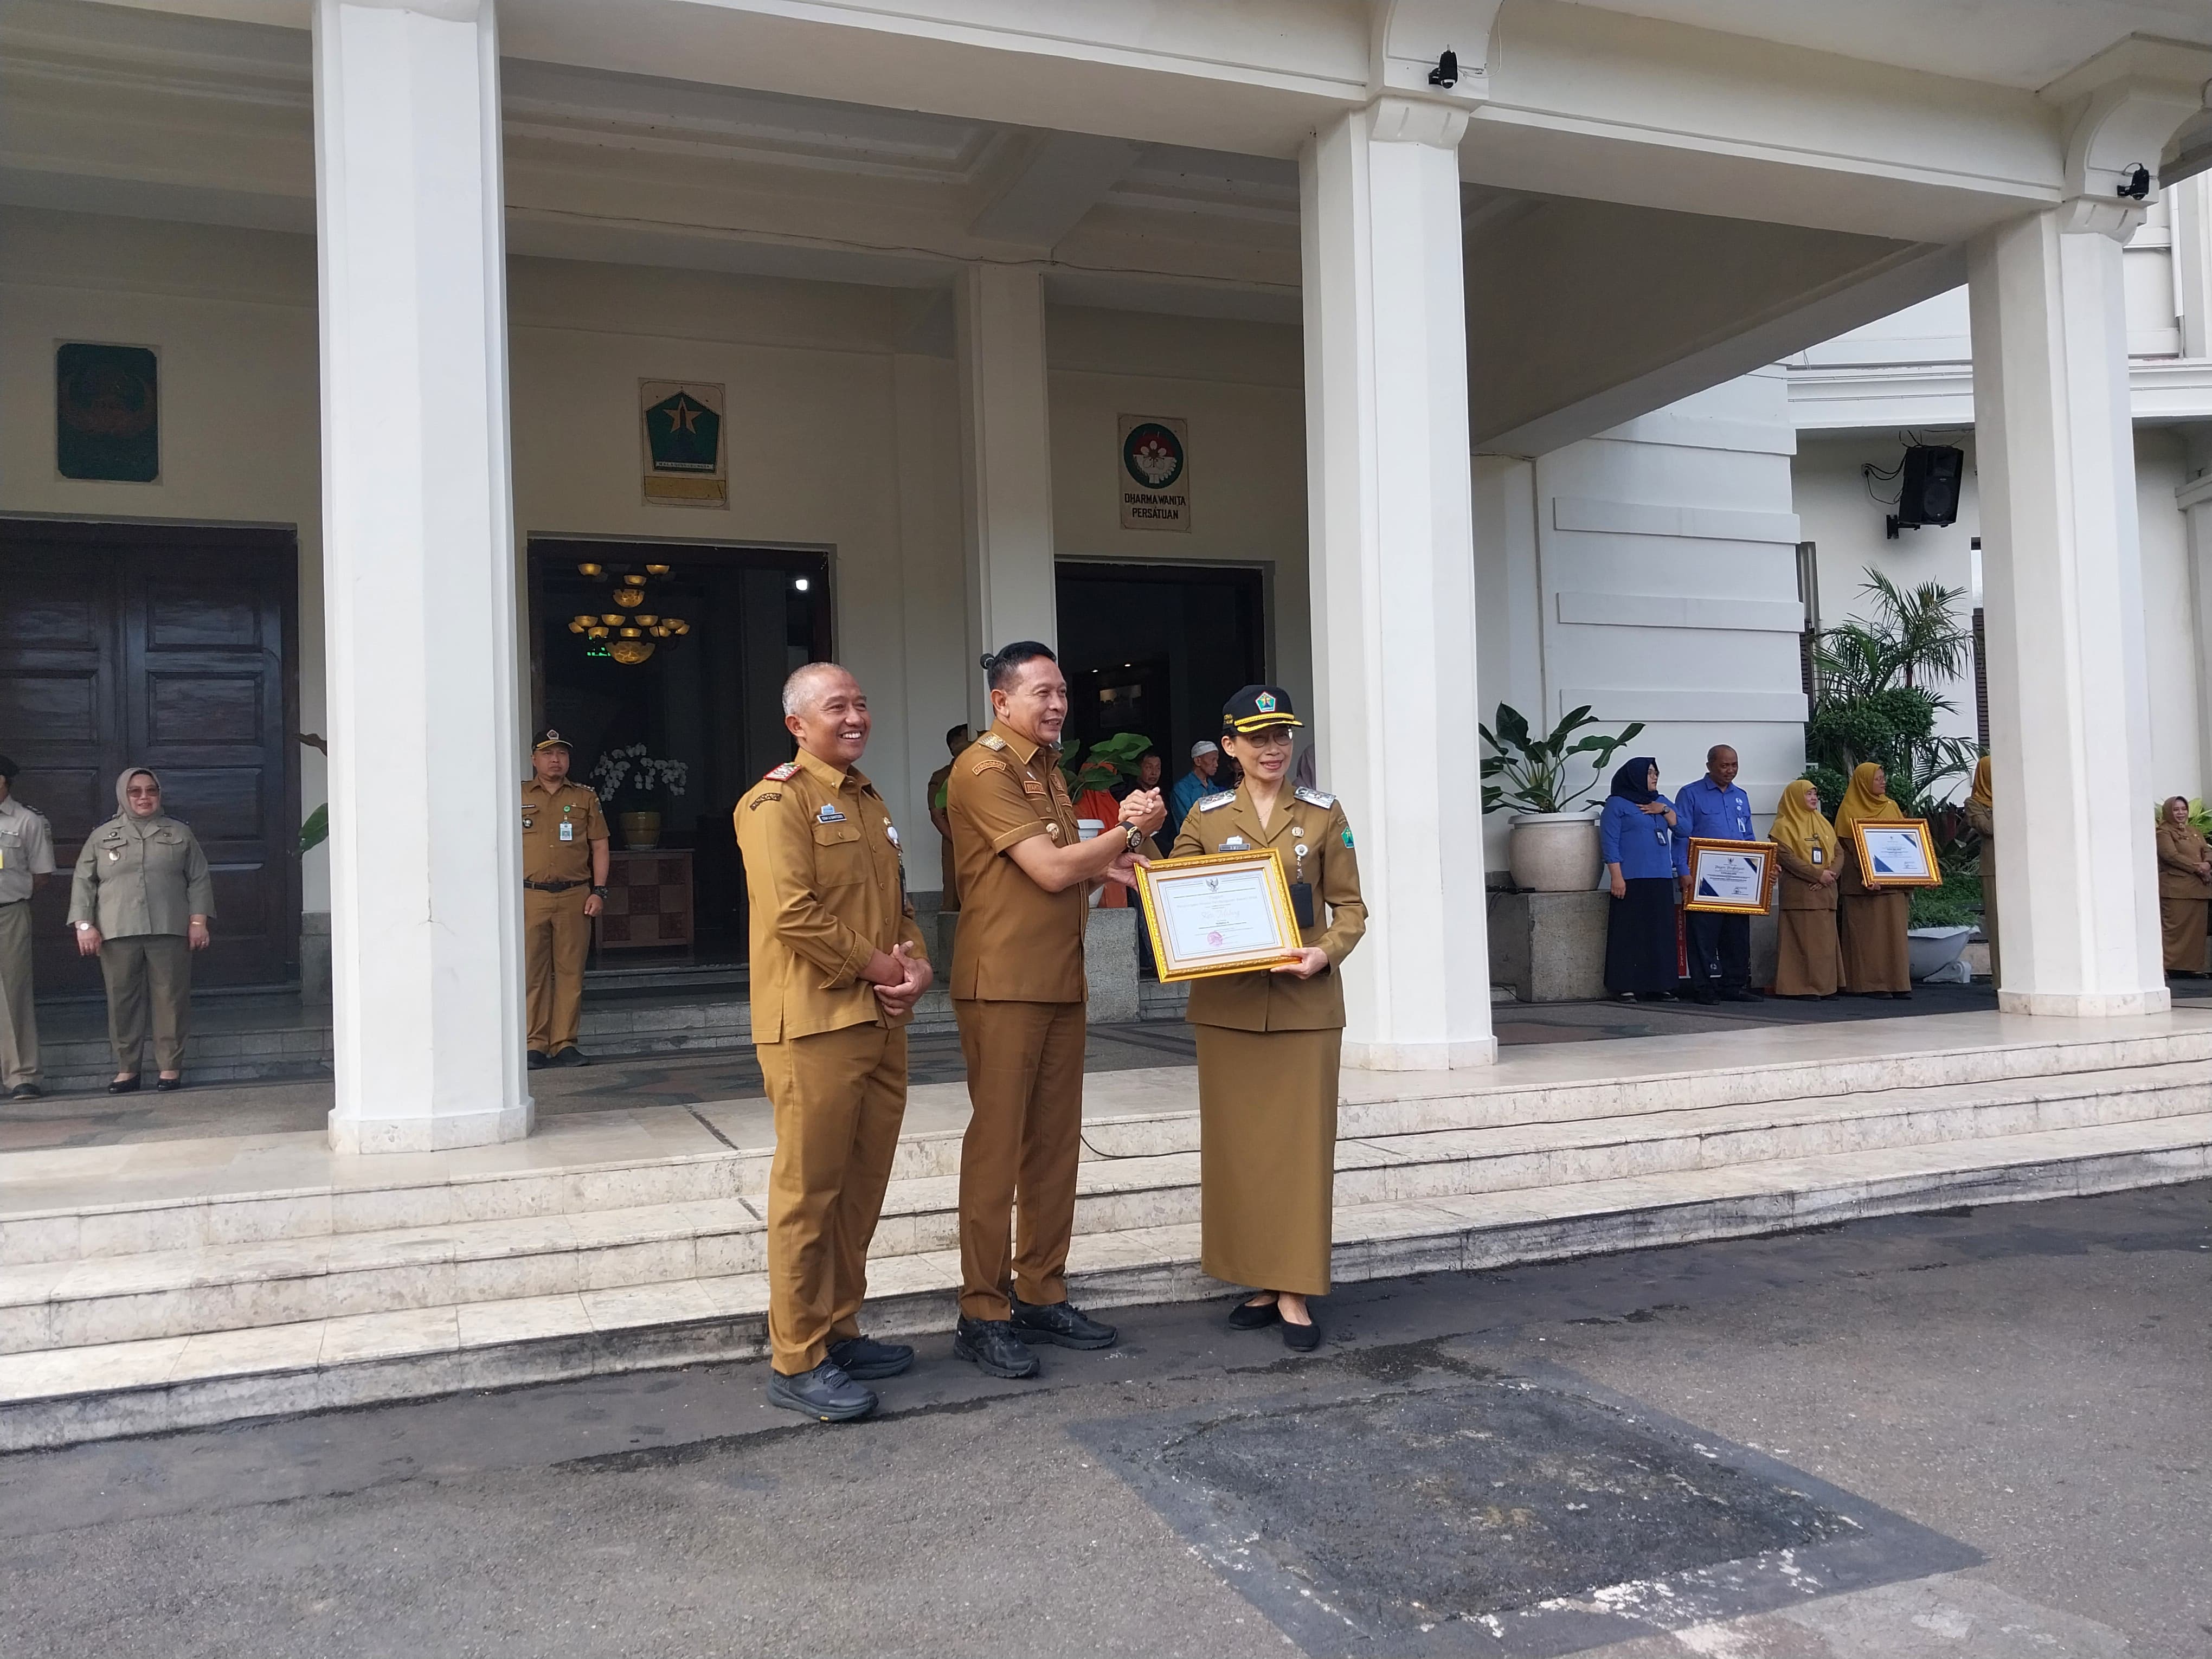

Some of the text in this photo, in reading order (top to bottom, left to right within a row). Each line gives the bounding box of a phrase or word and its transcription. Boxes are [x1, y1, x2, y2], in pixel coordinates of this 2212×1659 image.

[1124, 493, 1186, 506] DHARMA WANITA
[1132, 507, 1179, 519] PERSATUAN
